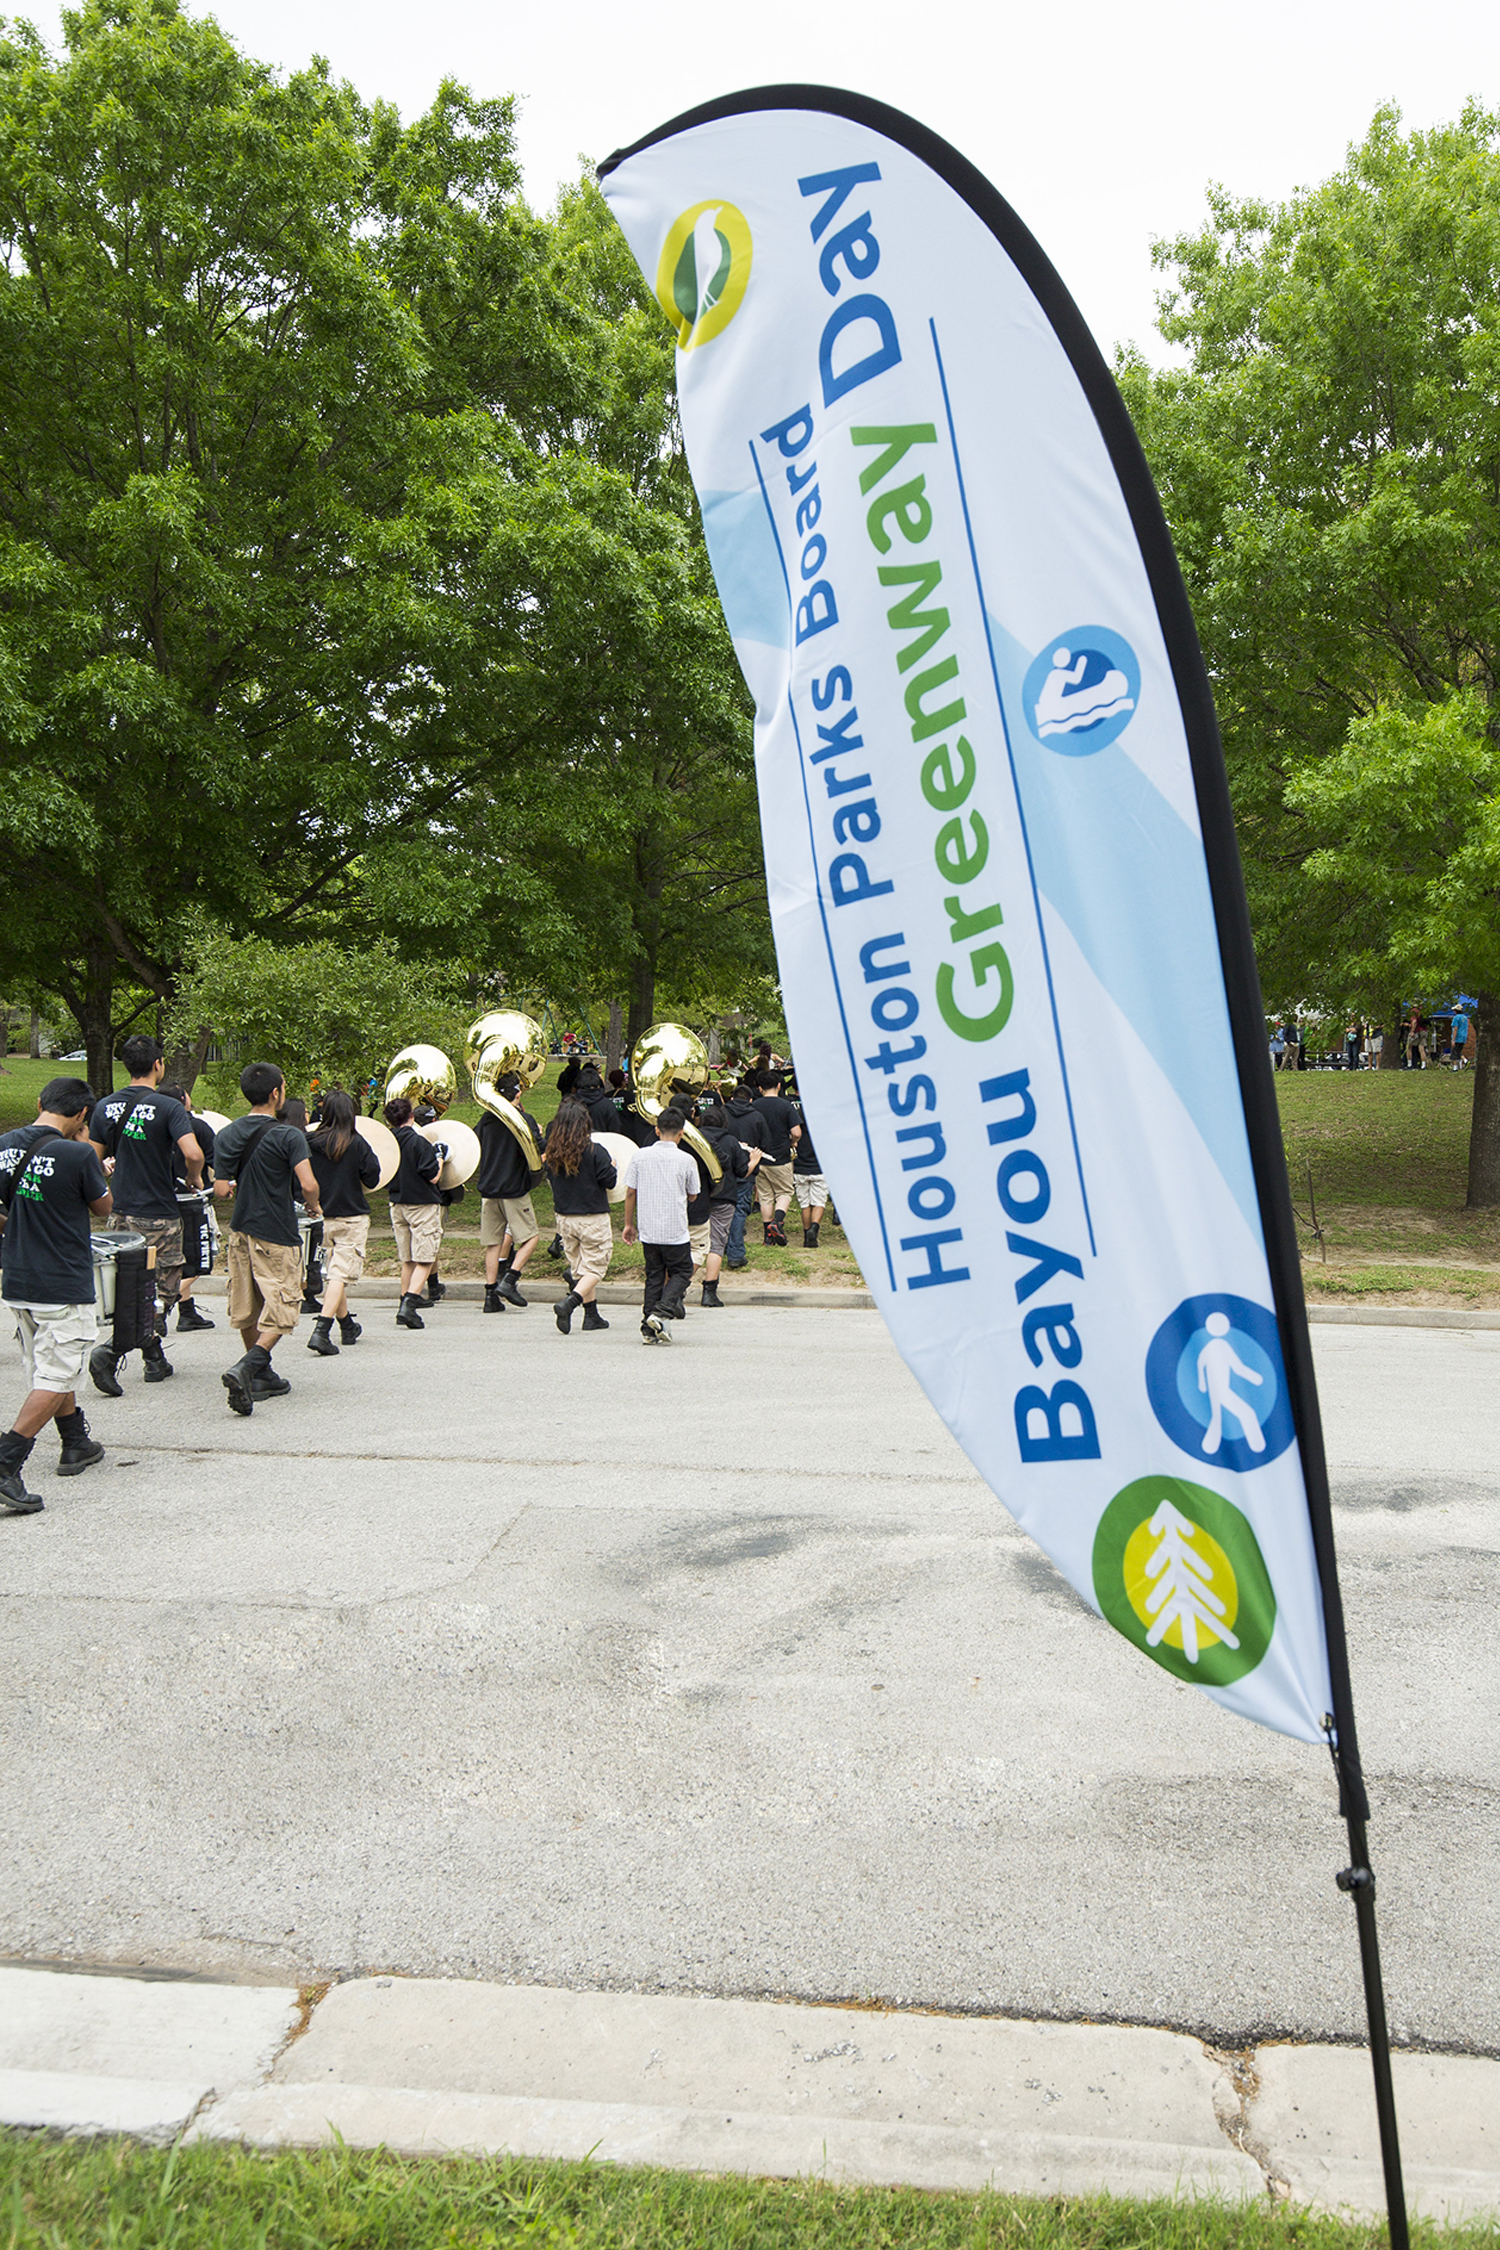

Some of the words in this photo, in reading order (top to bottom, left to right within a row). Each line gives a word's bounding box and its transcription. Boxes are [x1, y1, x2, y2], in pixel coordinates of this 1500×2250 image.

[797, 161, 903, 410] Day
[759, 403, 840, 648] Board
[809, 664, 895, 908] Parks
[850, 422, 1013, 1042] Greenway
[33, 1165, 55, 1177] GO
[138, 1111, 156, 1121] GO
[200, 1223, 210, 1240] VIC
[859, 932, 971, 1291] Houston
[978, 1067, 1102, 1464] Bayou
